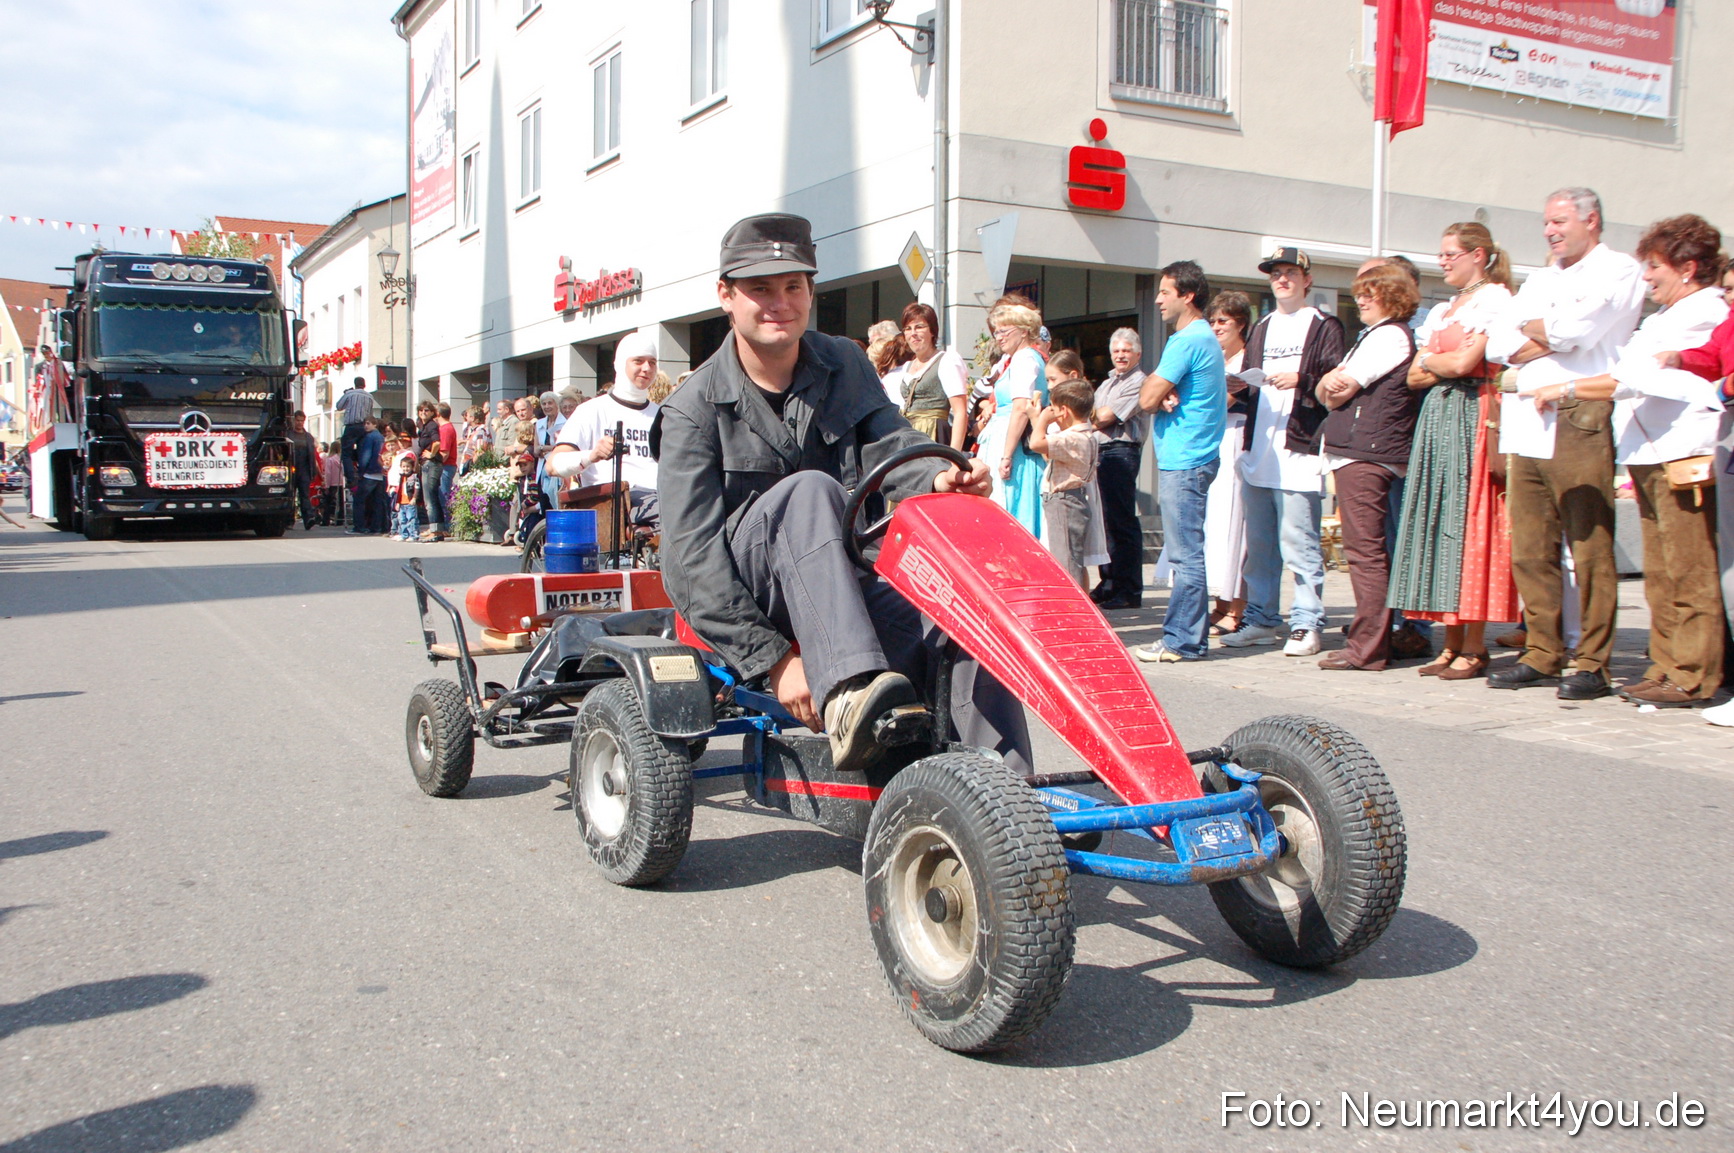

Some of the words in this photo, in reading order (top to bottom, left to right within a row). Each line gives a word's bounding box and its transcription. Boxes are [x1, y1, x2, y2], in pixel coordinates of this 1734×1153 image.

[1523, 2, 1577, 25] historische,
[1434, 2, 1456, 16] das
[1456, 6, 1495, 25] heutige
[1494, 12, 1560, 37] Stadtwappen
[1561, 27, 1626, 49] eingemauert?
[381, 379, 397, 387] Mode
[230, 391, 275, 401] LANGE
[176, 440, 215, 458] BRK
[155, 460, 238, 470] BETREUUNGSDIENST
[156, 471, 206, 481] BEILNGRIES
[900, 548, 955, 605] BERG
[546, 590, 623, 611] NOTARZT
[1051, 794, 1079, 811] RACER
